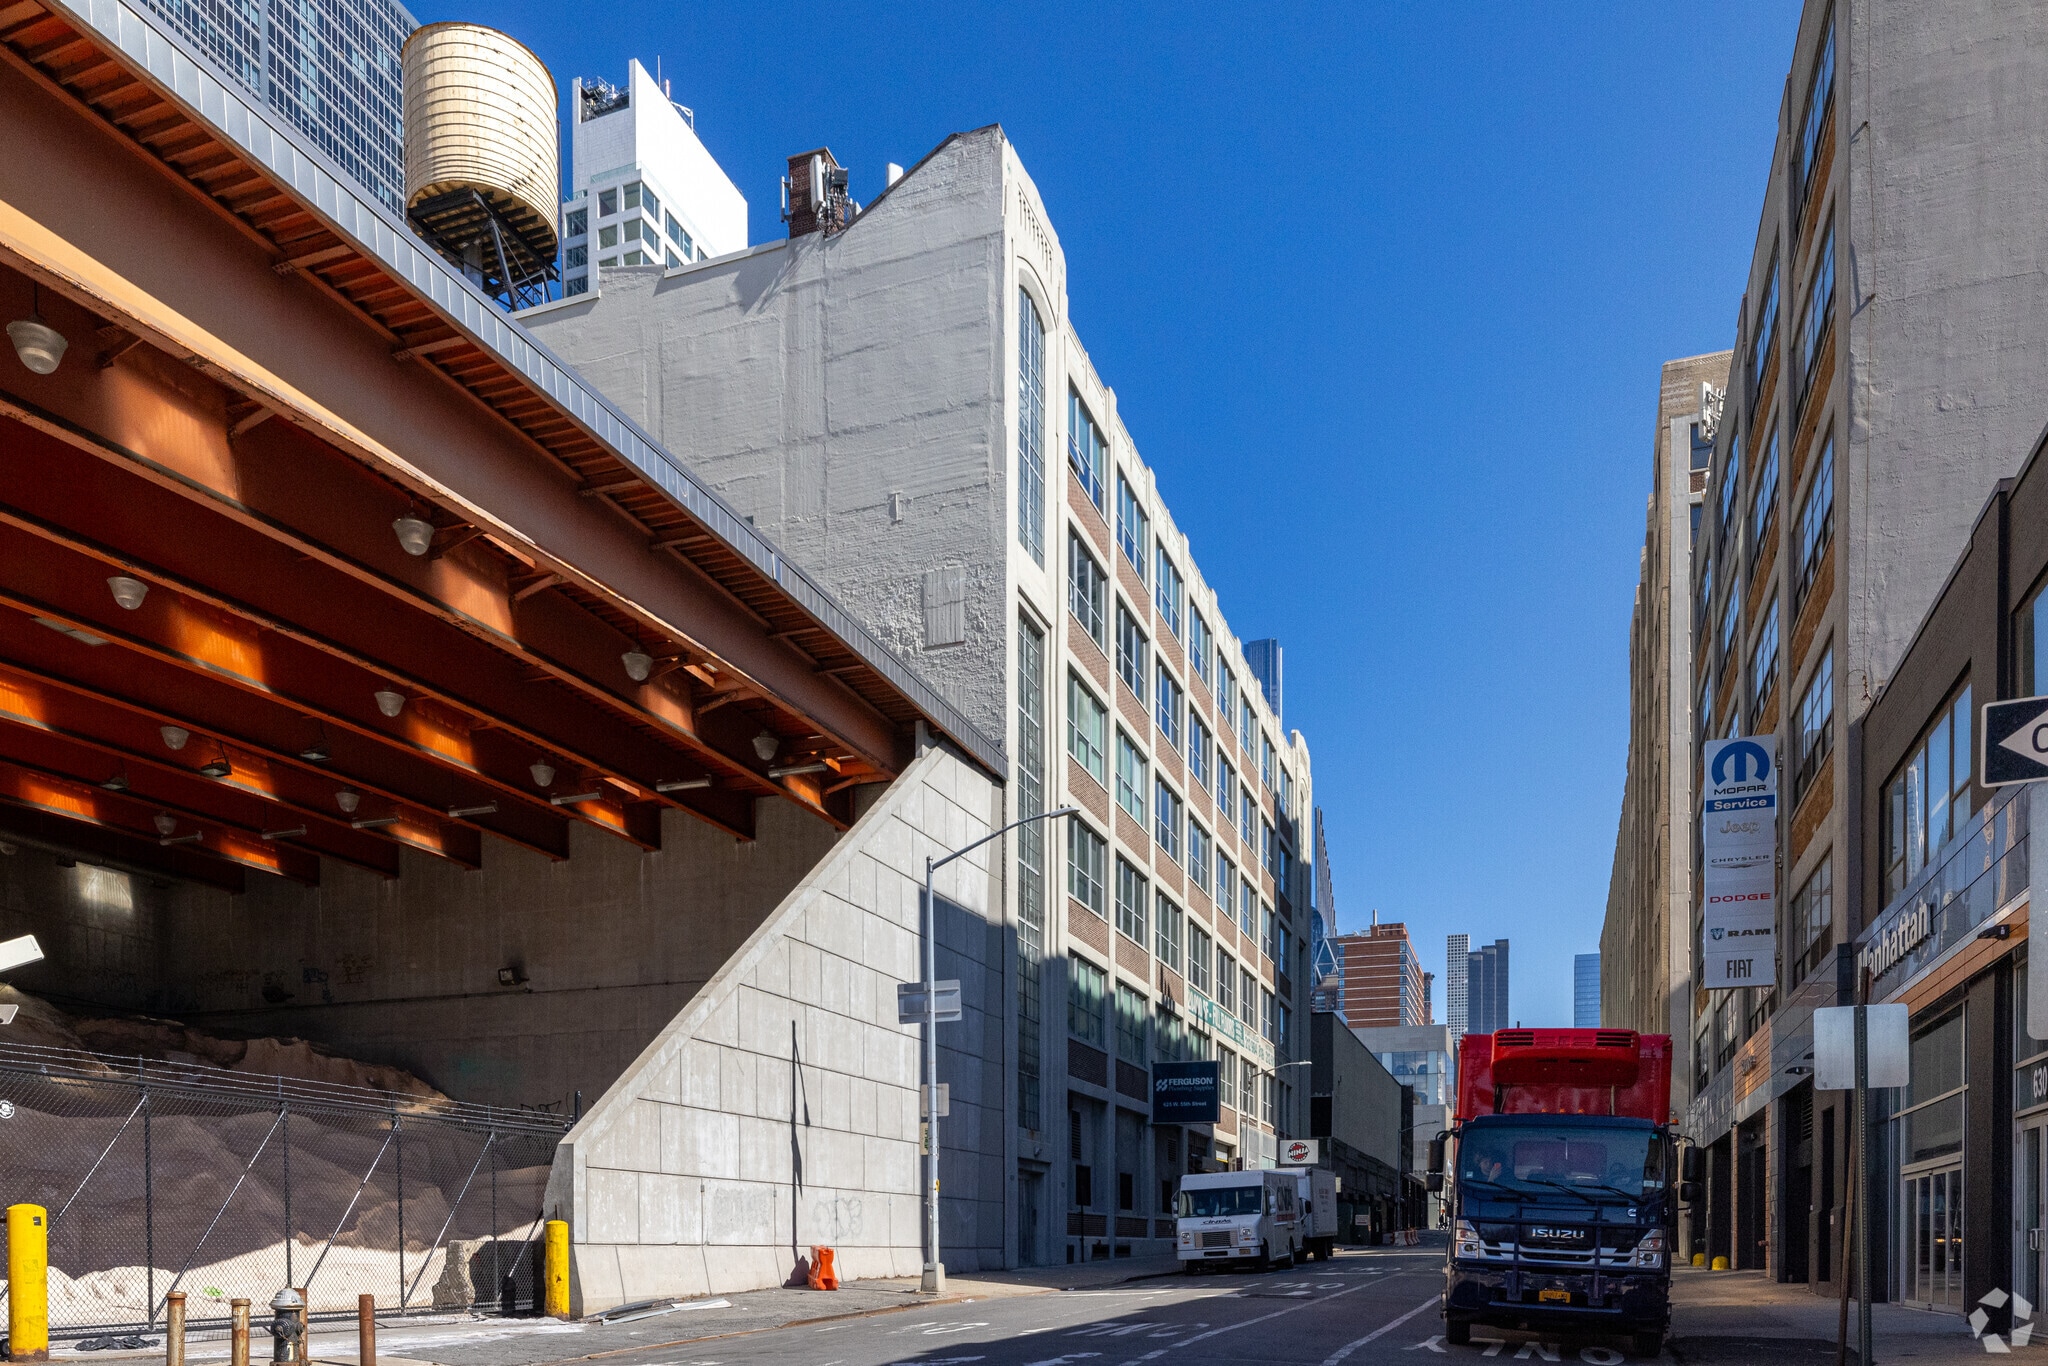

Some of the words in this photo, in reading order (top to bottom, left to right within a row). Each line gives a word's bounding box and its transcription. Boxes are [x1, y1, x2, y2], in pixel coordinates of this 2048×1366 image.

[1714, 784, 1767, 795] MOPAR
[1714, 799, 1767, 810] Service
[1720, 820, 1760, 834] Jeep
[1711, 854, 1770, 863] CHRYSLER
[1710, 893, 1771, 903] DODGE
[1728, 928, 1771, 937] RAM
[1726, 959, 1753, 978] FIAT
[1168, 1077, 1213, 1086] FERGUSON
[2033, 1066, 2048, 1098] 630
[1288, 1147, 1309, 1157] NINJA
[1532, 1228, 1585, 1239] ISUZU
